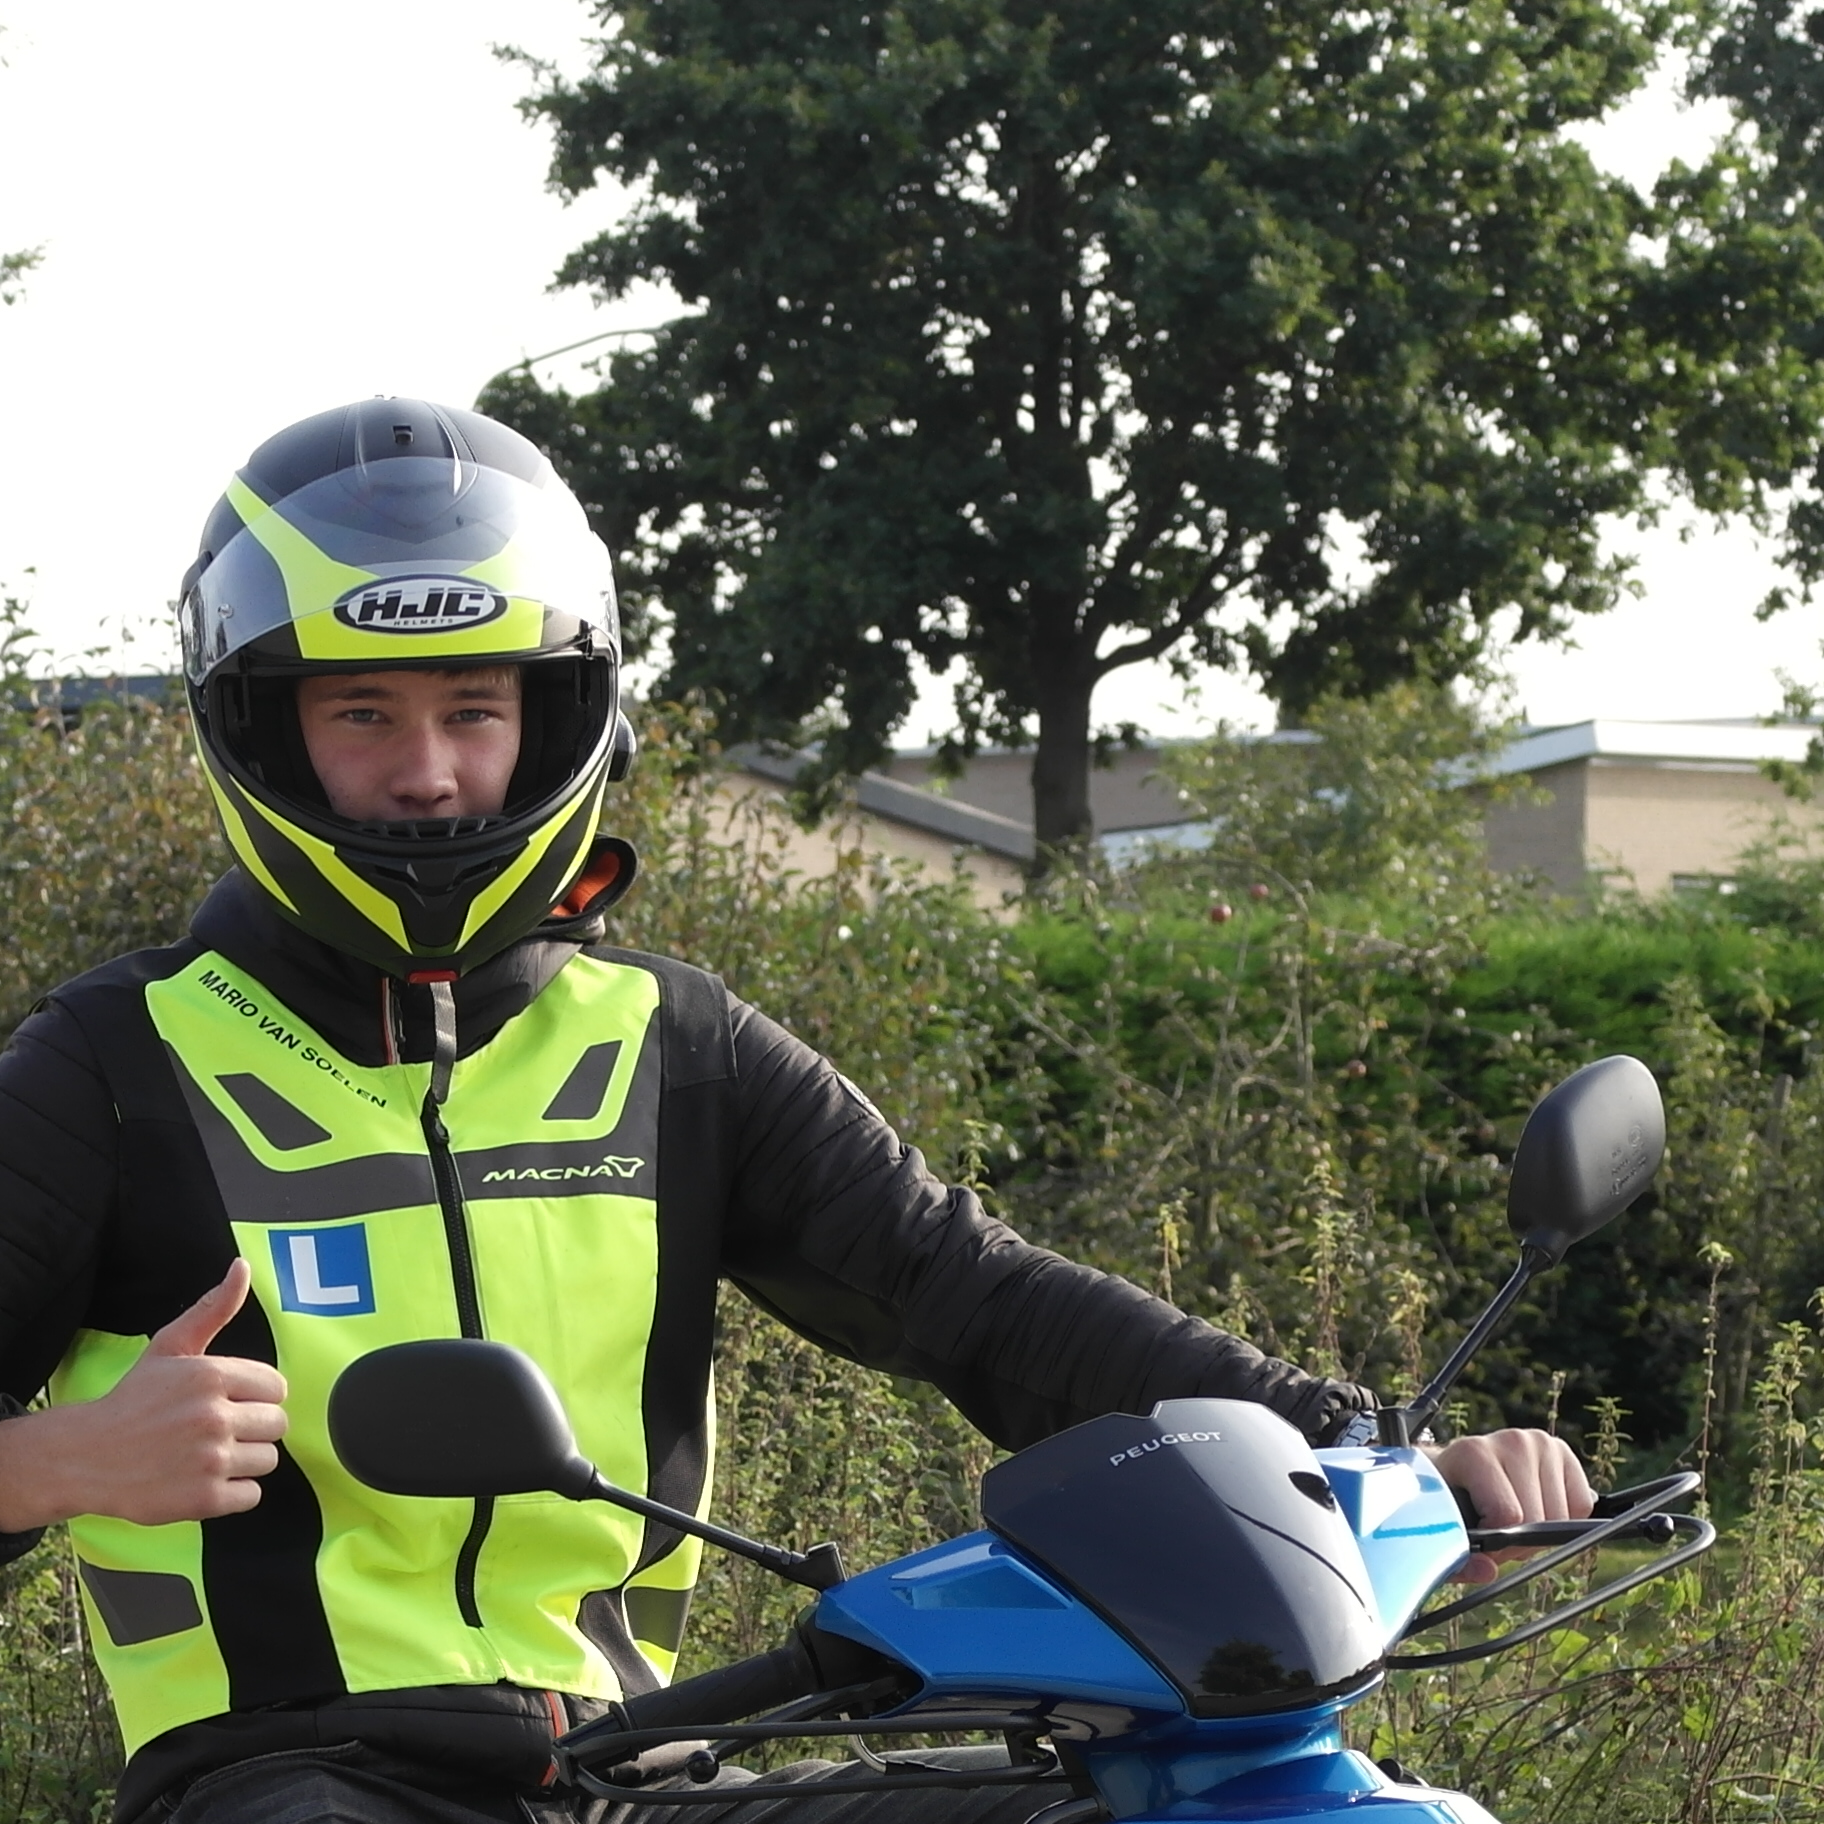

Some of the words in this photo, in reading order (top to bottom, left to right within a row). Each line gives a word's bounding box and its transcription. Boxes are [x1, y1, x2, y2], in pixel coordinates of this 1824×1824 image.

[357, 588, 487, 623] HJC
[393, 618, 454, 627] HELMETS
[197, 969, 260, 1018] MARIO
[257, 1015, 302, 1051] VAN
[300, 1046, 388, 1109] SOELEN
[481, 1164, 614, 1183] MACNA
[288, 1235, 361, 1305] L
[1109, 1431, 1222, 1467] PEUGEOT
